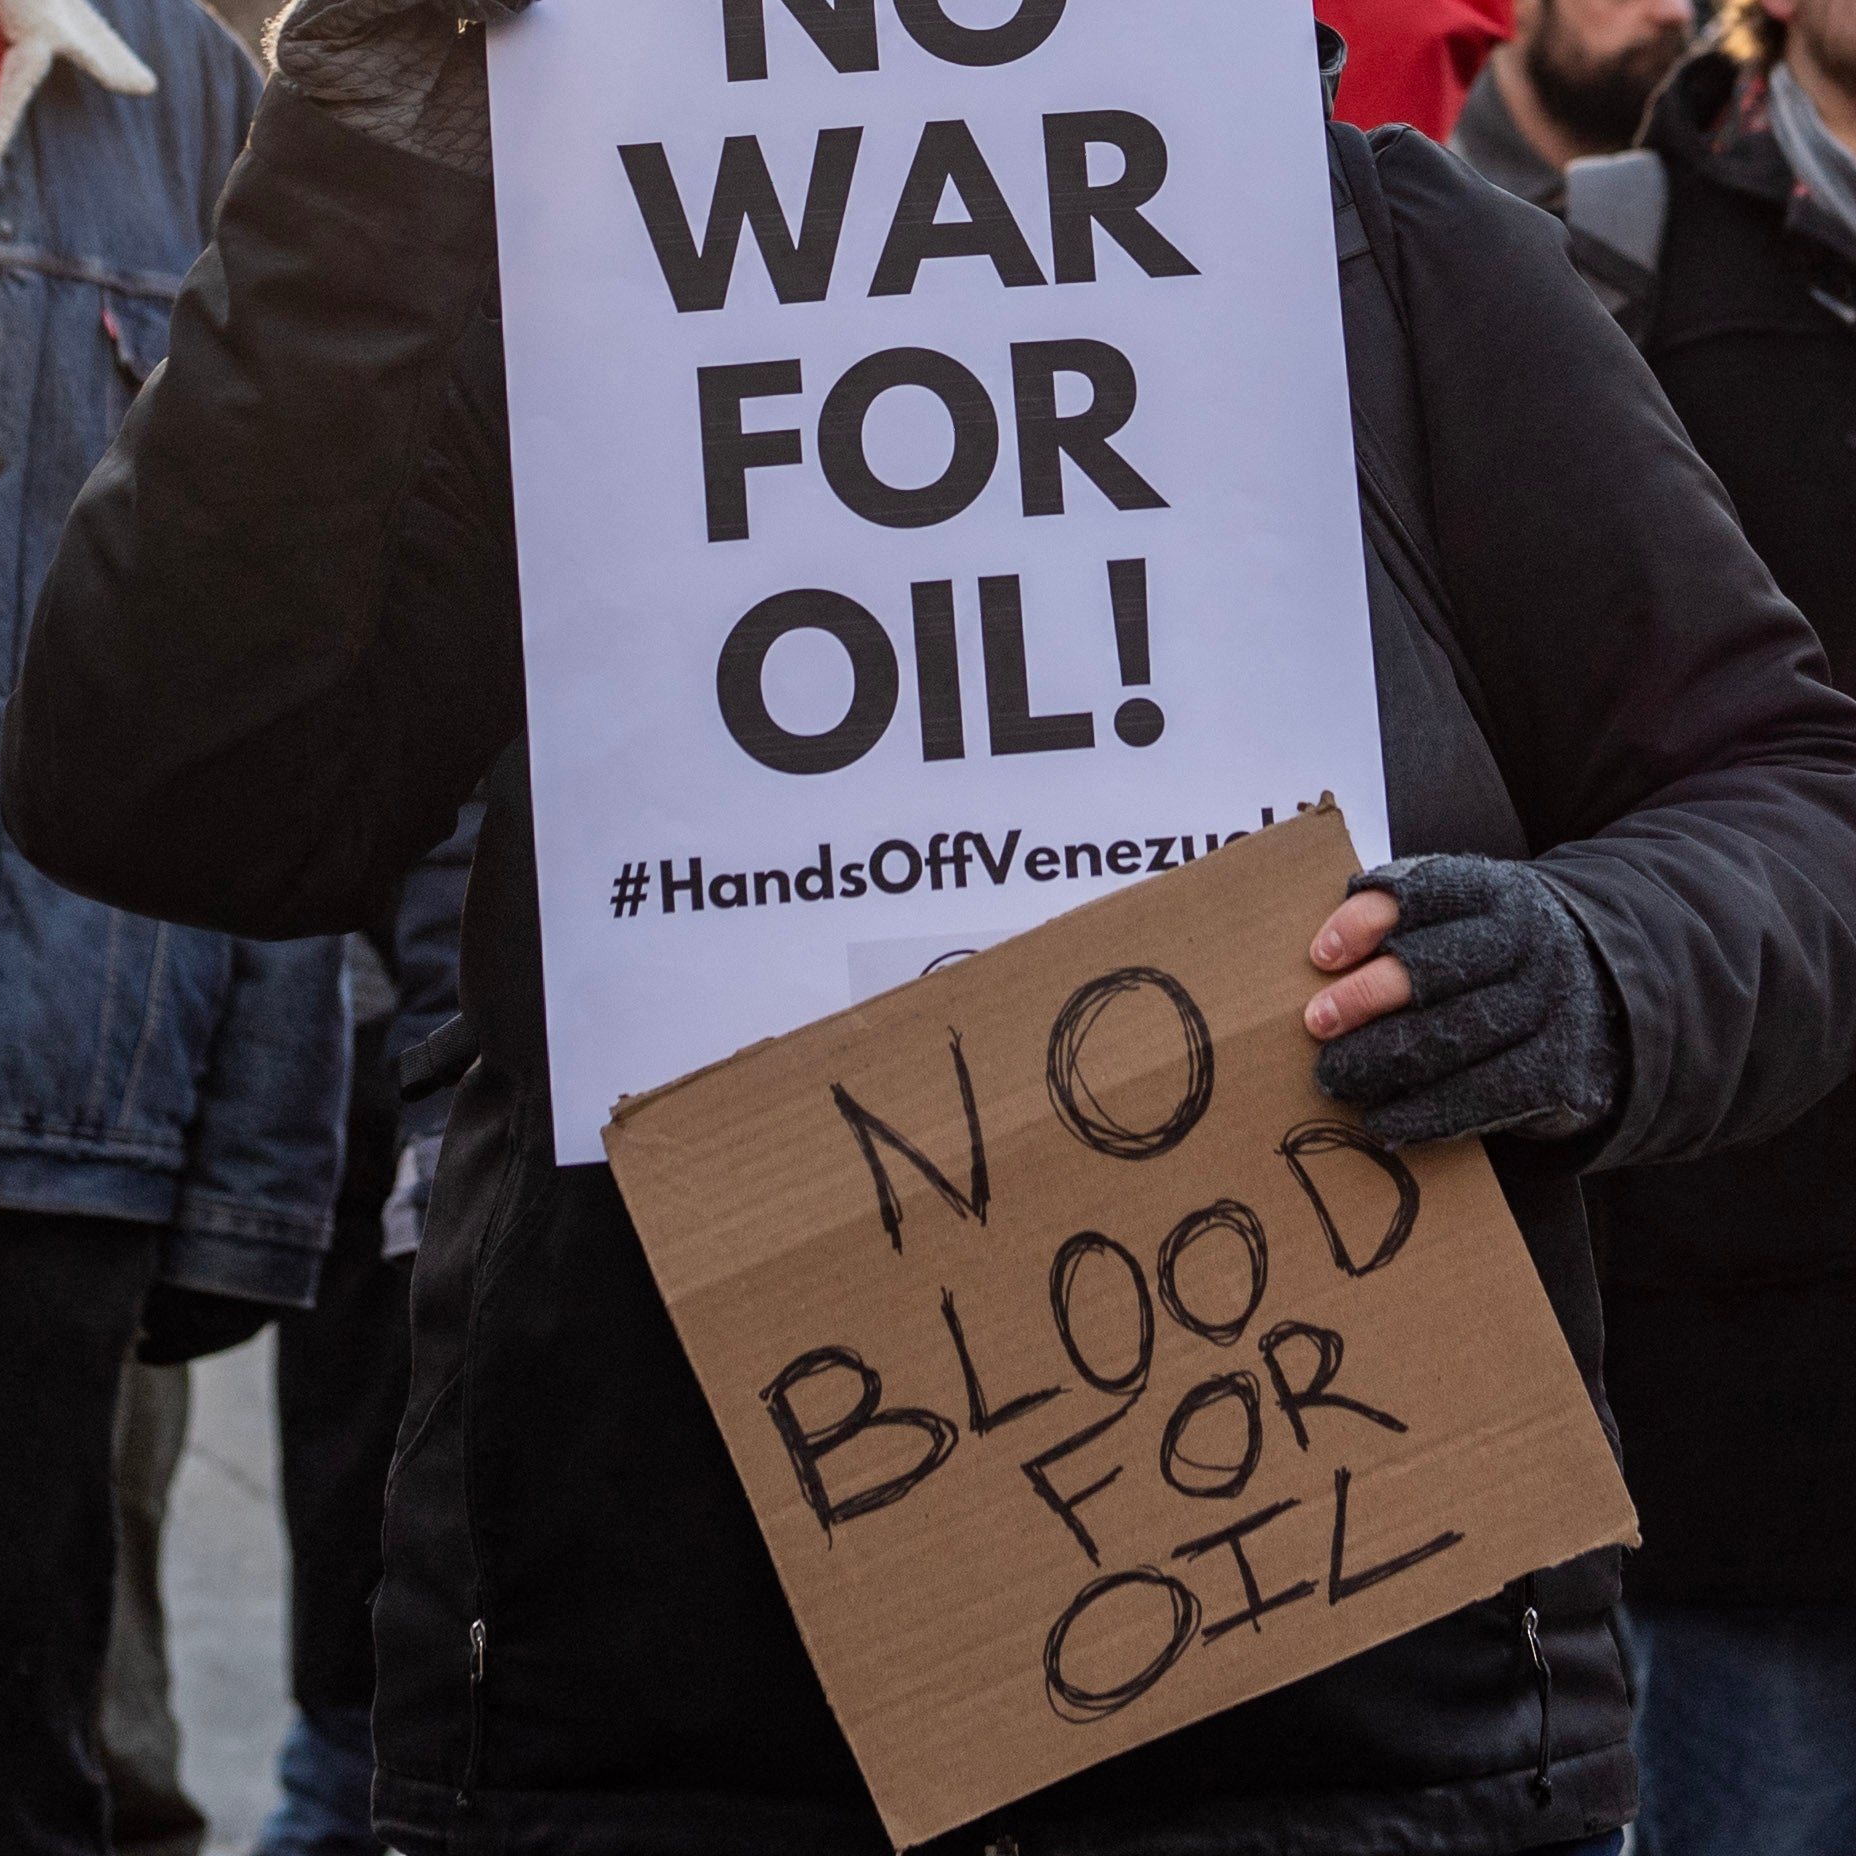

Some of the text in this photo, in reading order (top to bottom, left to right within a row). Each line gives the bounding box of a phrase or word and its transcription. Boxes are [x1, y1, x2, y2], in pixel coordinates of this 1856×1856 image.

[615, 108, 1203, 315] WAR
[695, 337, 1172, 545] FOR
[714, 556, 1167, 777] OIL!
[610, 806, 1276, 919] #HandsOffVenezu
[828, 964, 1217, 1256] NO
[758, 1117, 1423, 1548] BLOOD
[1019, 1320, 1410, 1569] FOR
[1043, 1466, 1467, 1724] OIL
